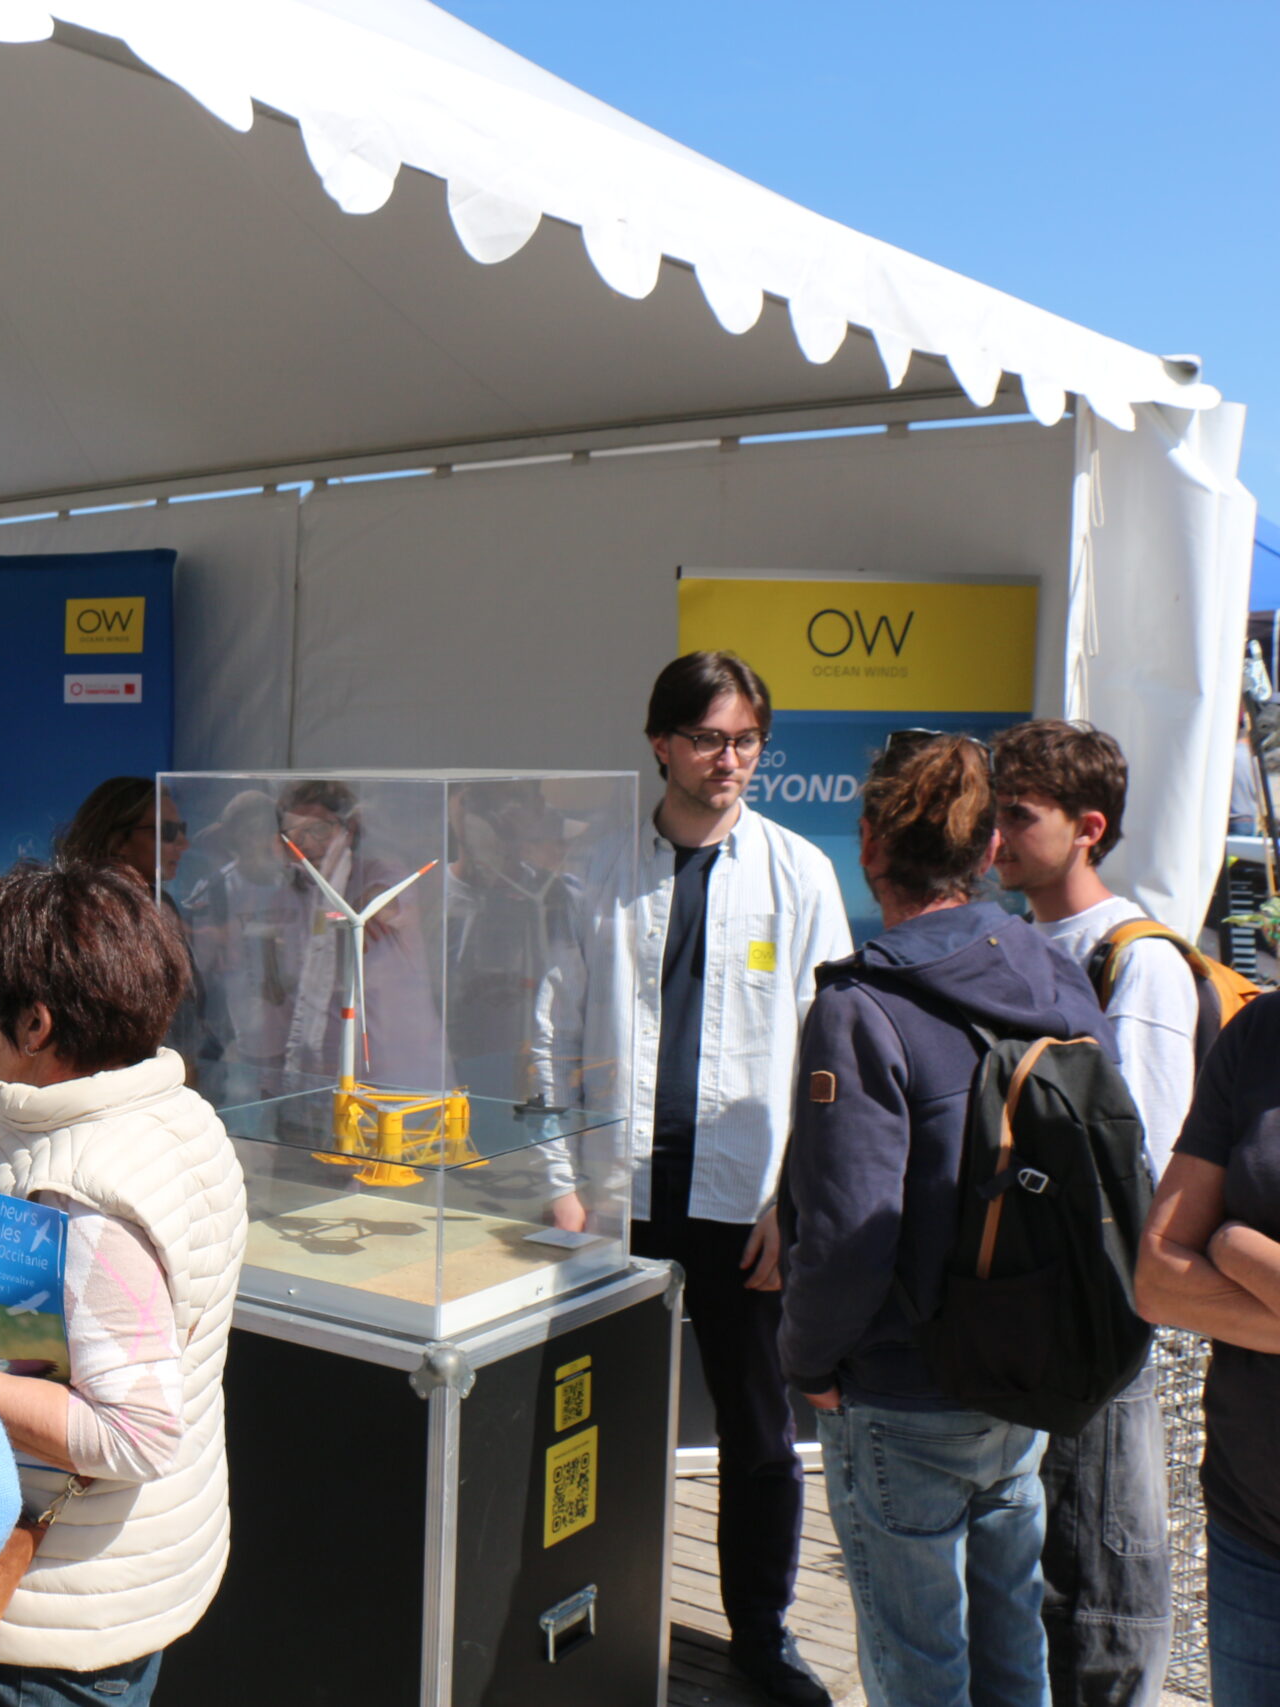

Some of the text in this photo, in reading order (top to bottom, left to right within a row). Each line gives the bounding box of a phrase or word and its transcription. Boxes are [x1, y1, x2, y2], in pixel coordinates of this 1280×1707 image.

[76, 608, 134, 634] OW
[807, 608, 915, 658] OW
[812, 664, 908, 678] OCEAN WINDS
[758, 750, 786, 768] GO
[742, 774, 858, 803] EYOND
